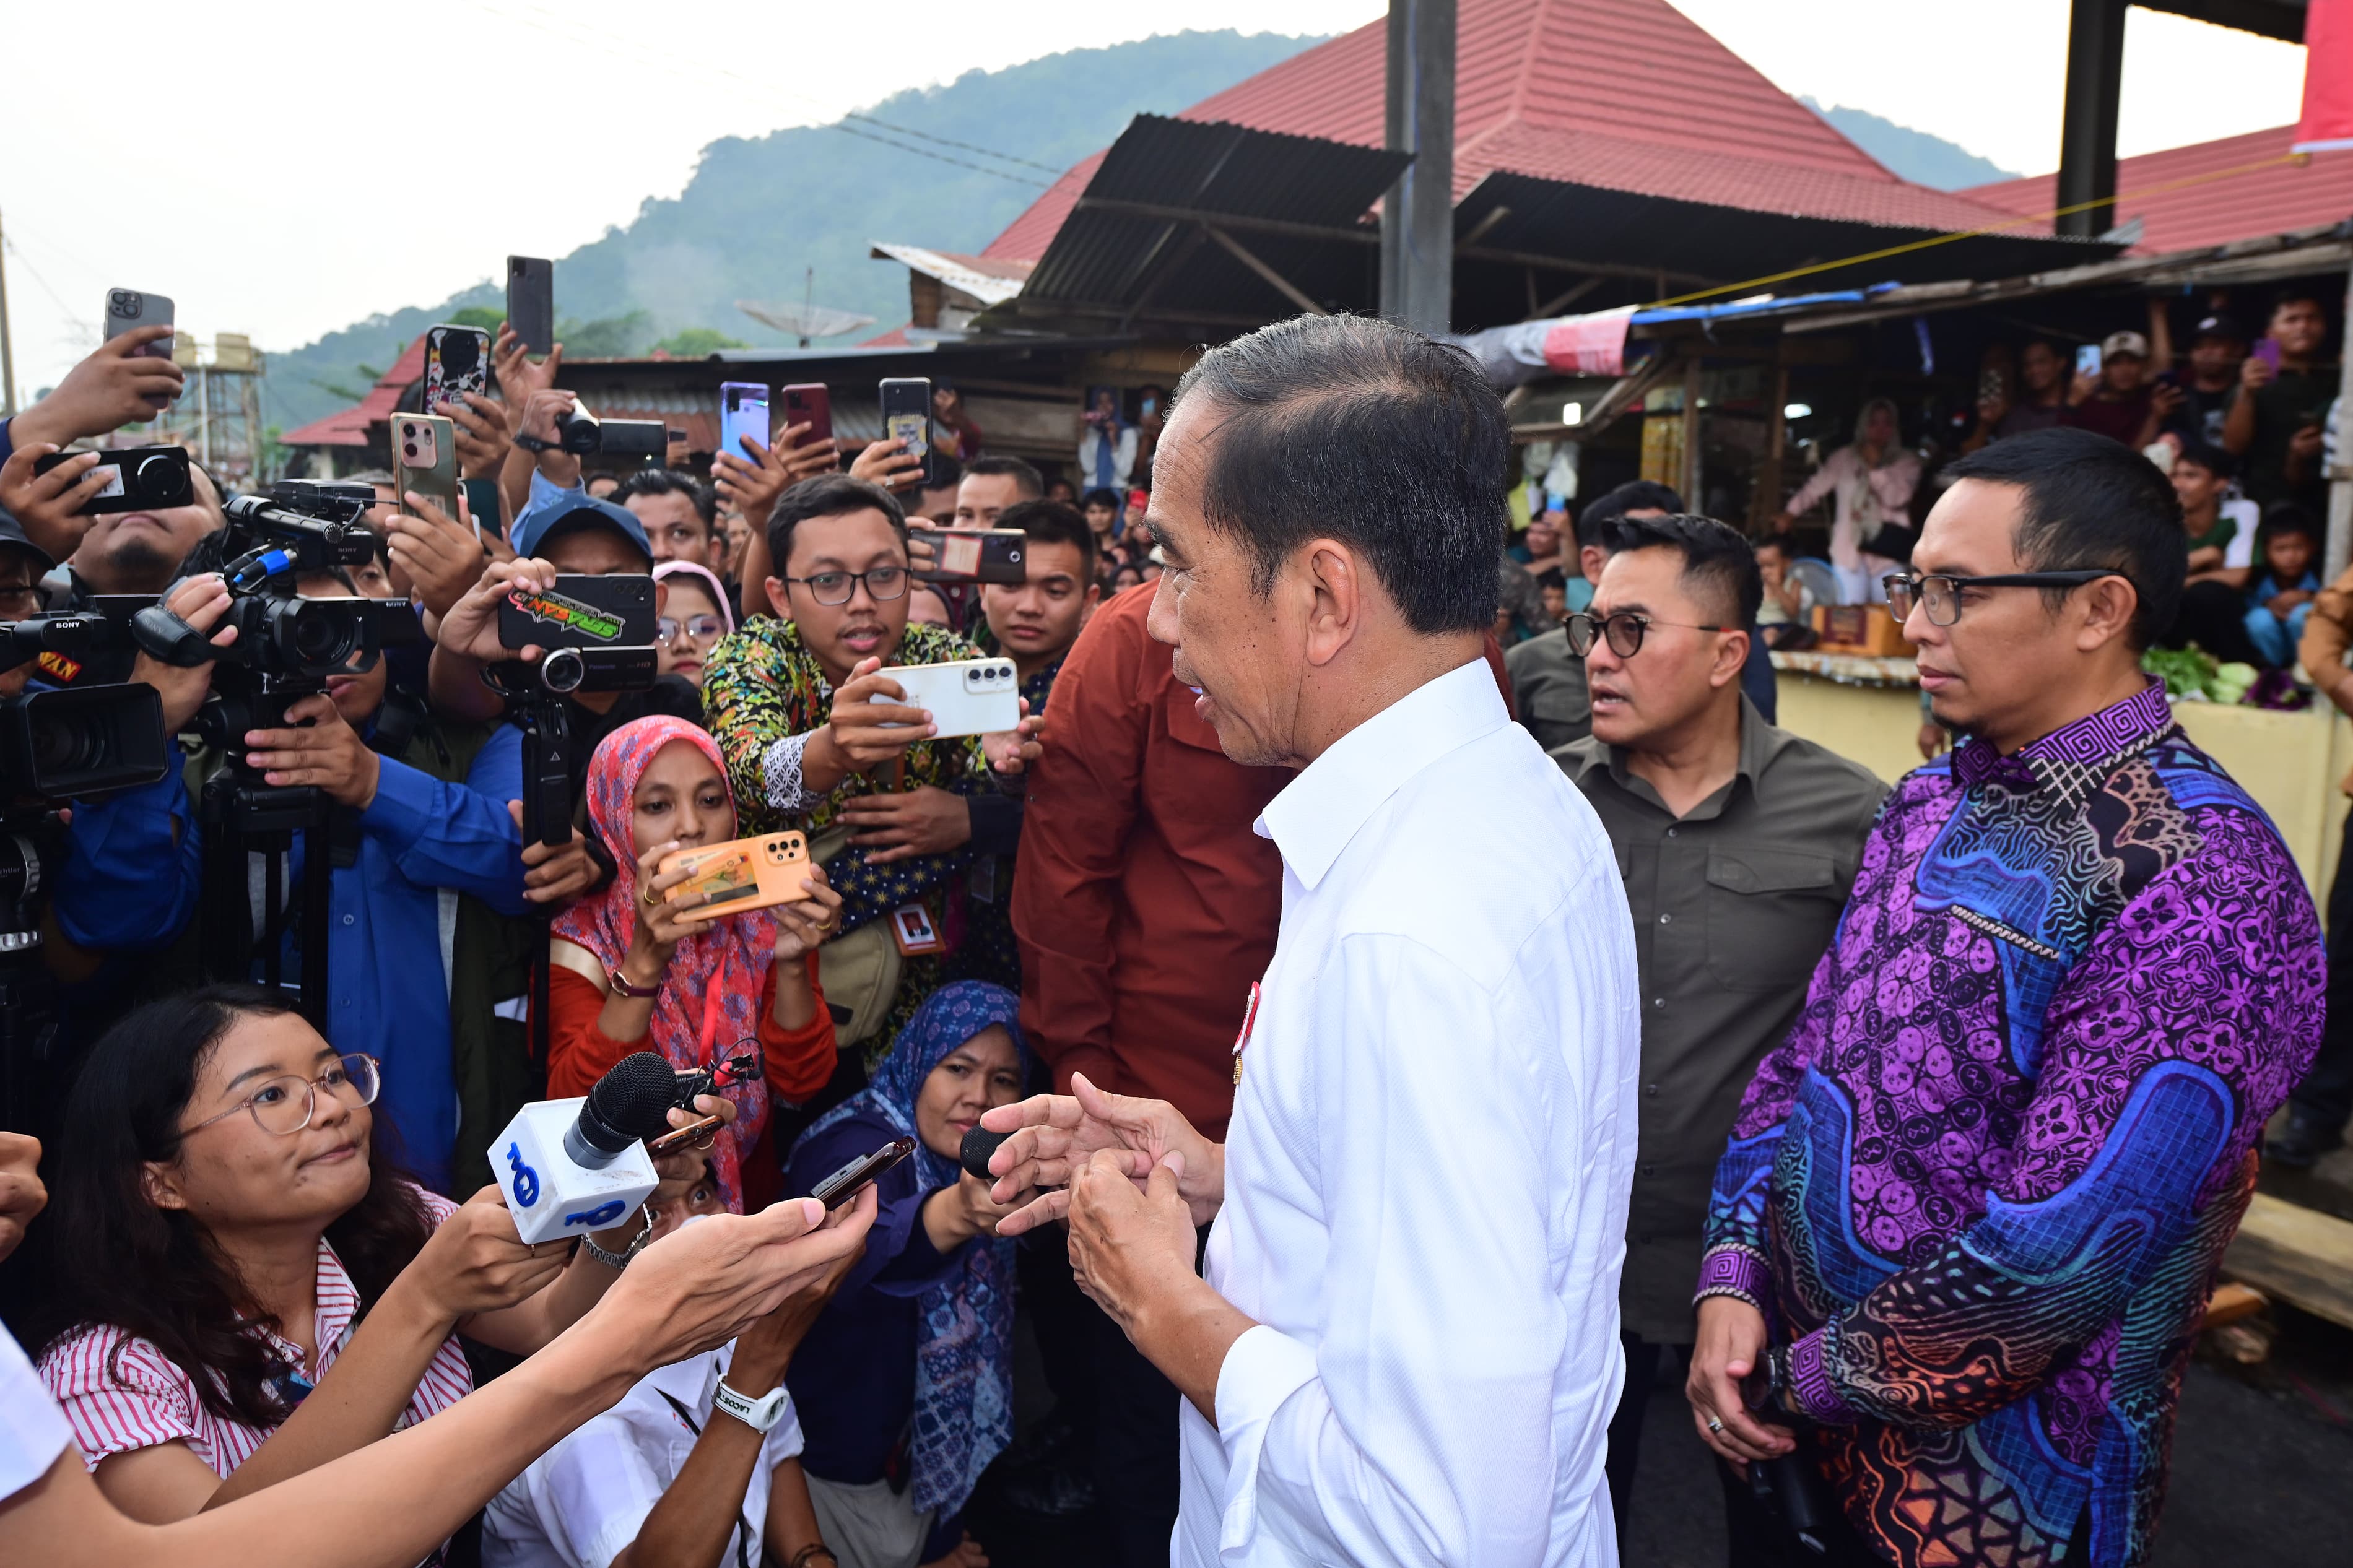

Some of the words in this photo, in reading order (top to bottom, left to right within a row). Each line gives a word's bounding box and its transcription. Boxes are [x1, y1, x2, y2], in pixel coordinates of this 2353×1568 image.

[56, 621, 80, 630] SONY
[601, 1121, 633, 1138] SENNHEISER
[506, 1141, 540, 1208] TVRI
[563, 1200, 627, 1226] TVR
